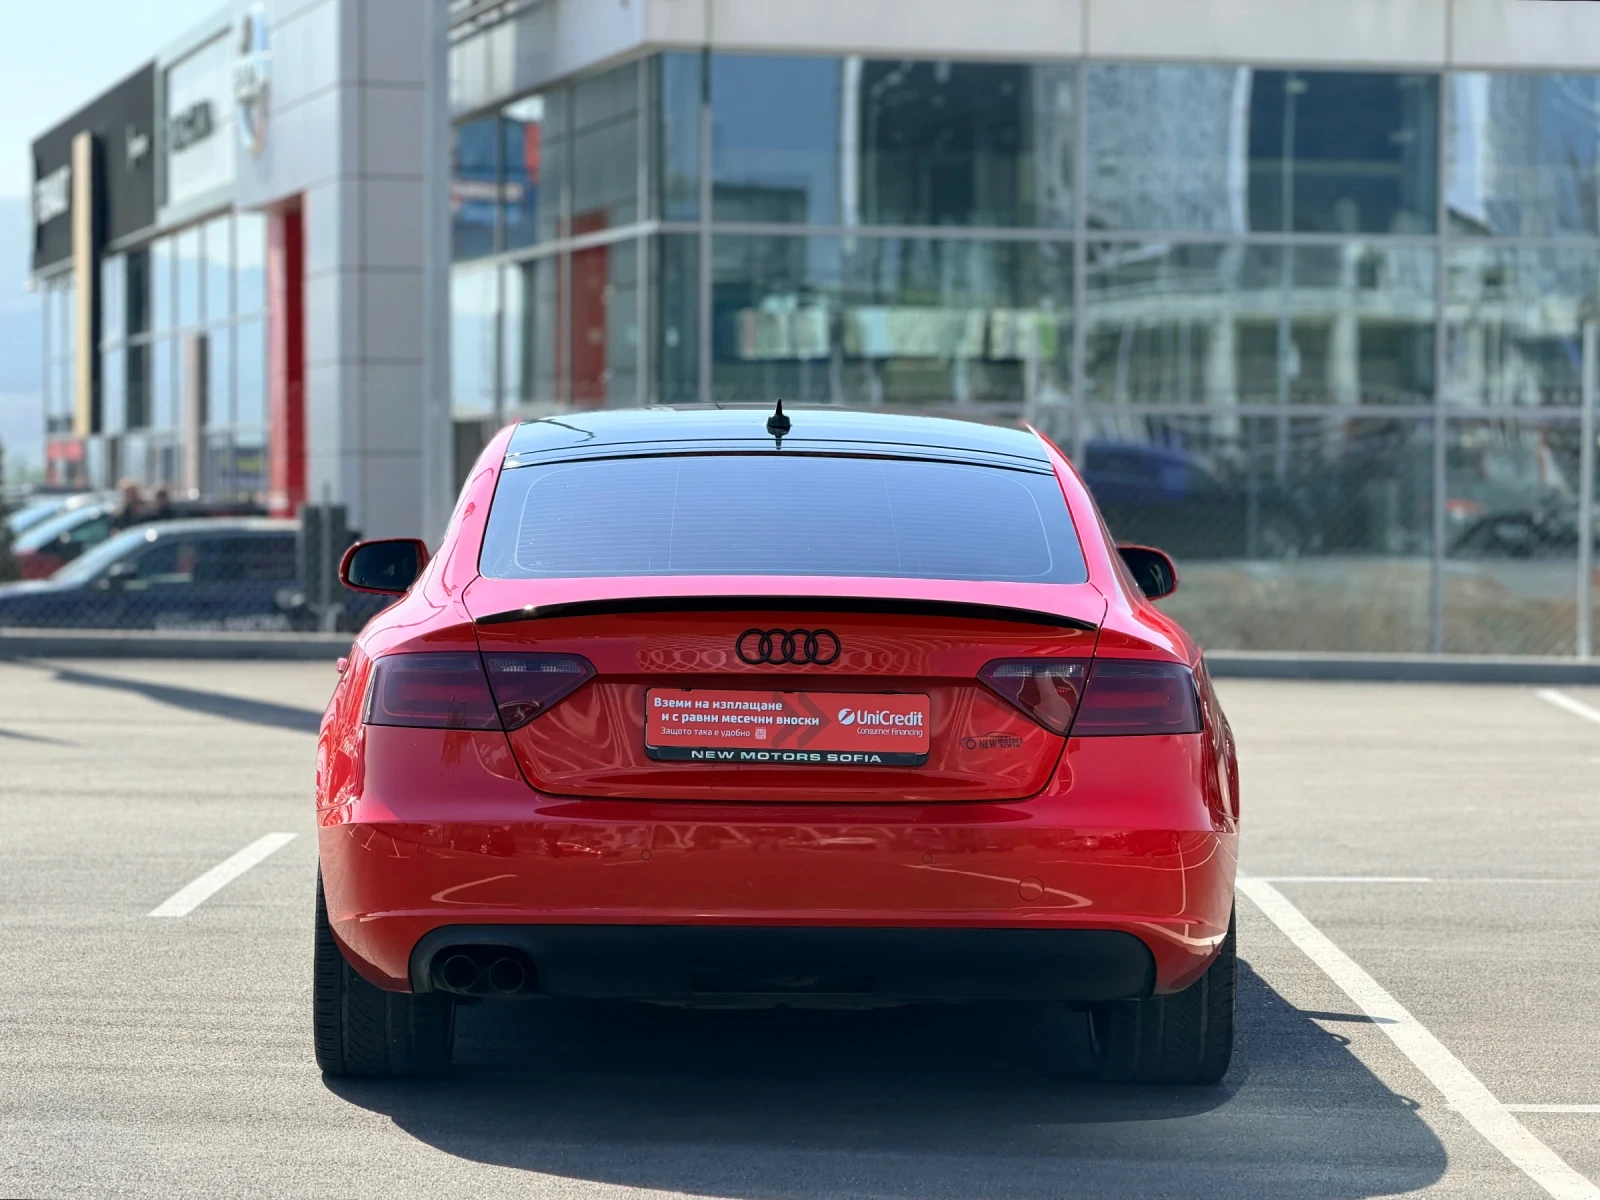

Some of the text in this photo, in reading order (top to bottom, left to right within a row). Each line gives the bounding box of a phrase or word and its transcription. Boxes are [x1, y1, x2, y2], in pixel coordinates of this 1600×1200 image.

[653, 697, 783, 712] Вземи на изплащане
[661, 712, 820, 726] и с равни месечни вноски
[857, 710, 924, 726] UniCredit
[660, 727, 692, 736] Защото
[721, 728, 751, 737] удобно
[856, 727, 924, 738] Consumer Financing
[979, 739, 997, 749] NEW
[691, 750, 882, 763] NEW MOTORS SOFIA
